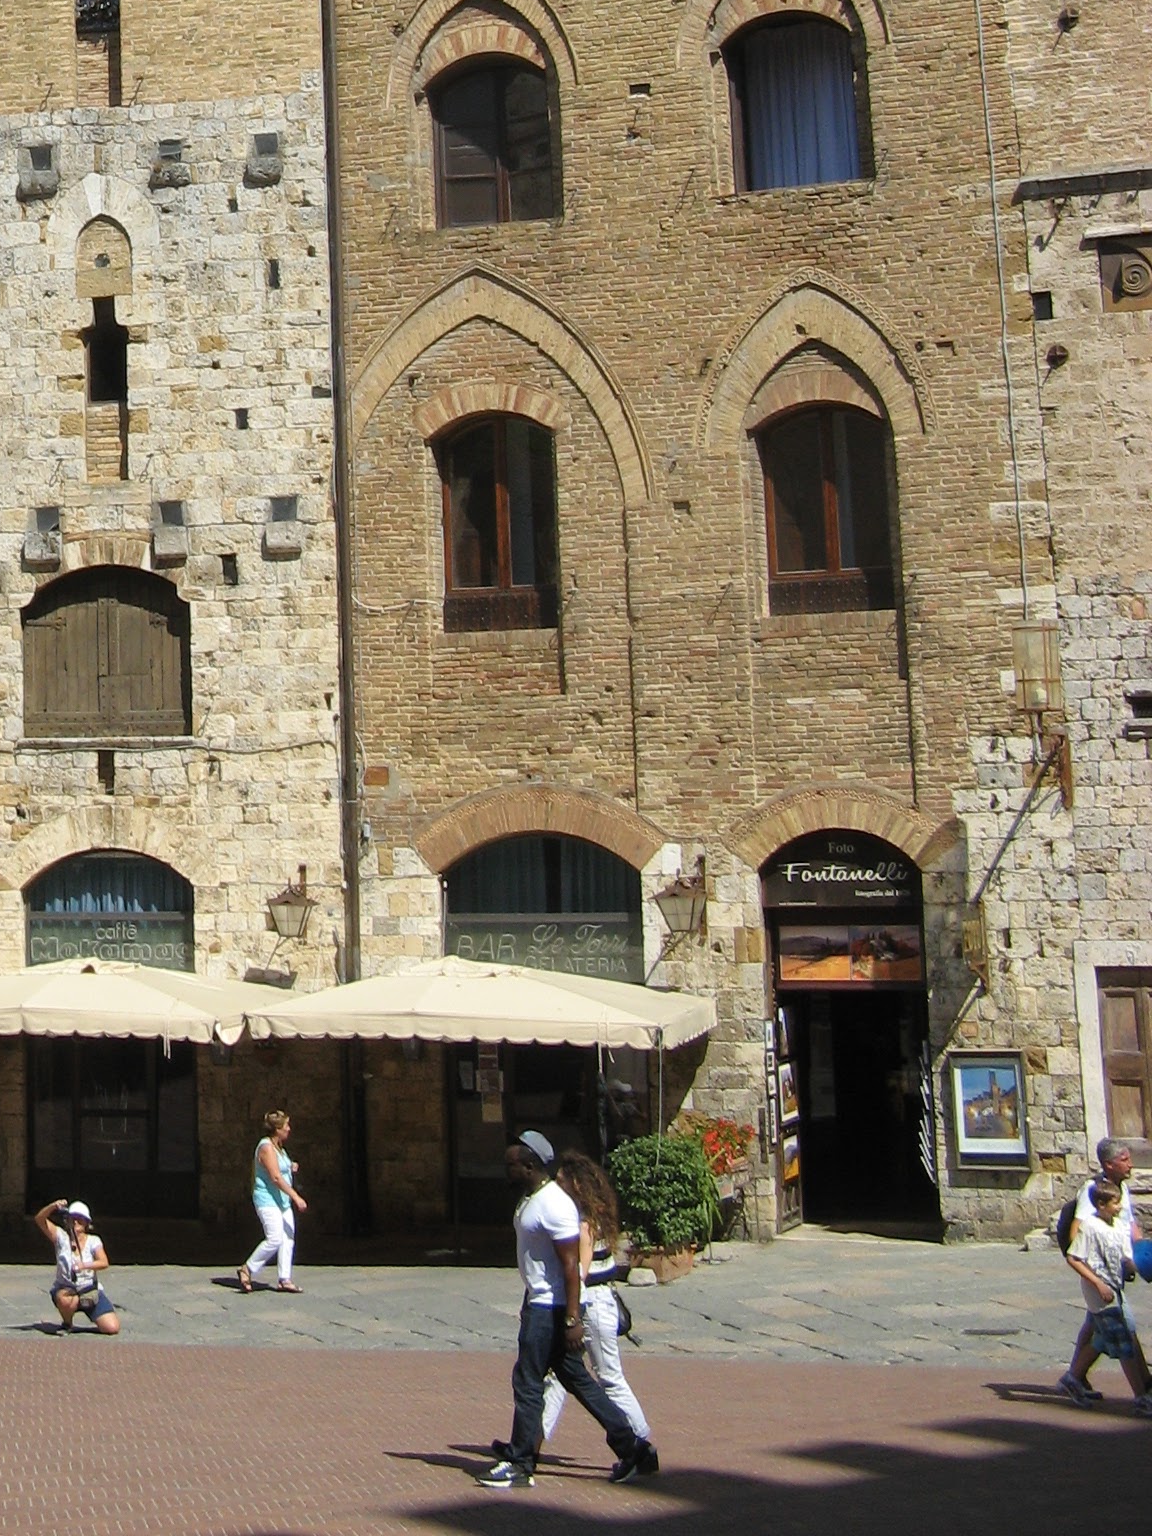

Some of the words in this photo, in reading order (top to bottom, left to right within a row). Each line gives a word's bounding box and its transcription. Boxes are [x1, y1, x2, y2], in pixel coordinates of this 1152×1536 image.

[828, 842, 854, 854] Foto
[778, 861, 908, 883] Fontanelli
[457, 933, 516, 961] BAR
[527, 924, 565, 954] Le
[524, 956, 628, 973] GELATERIA
